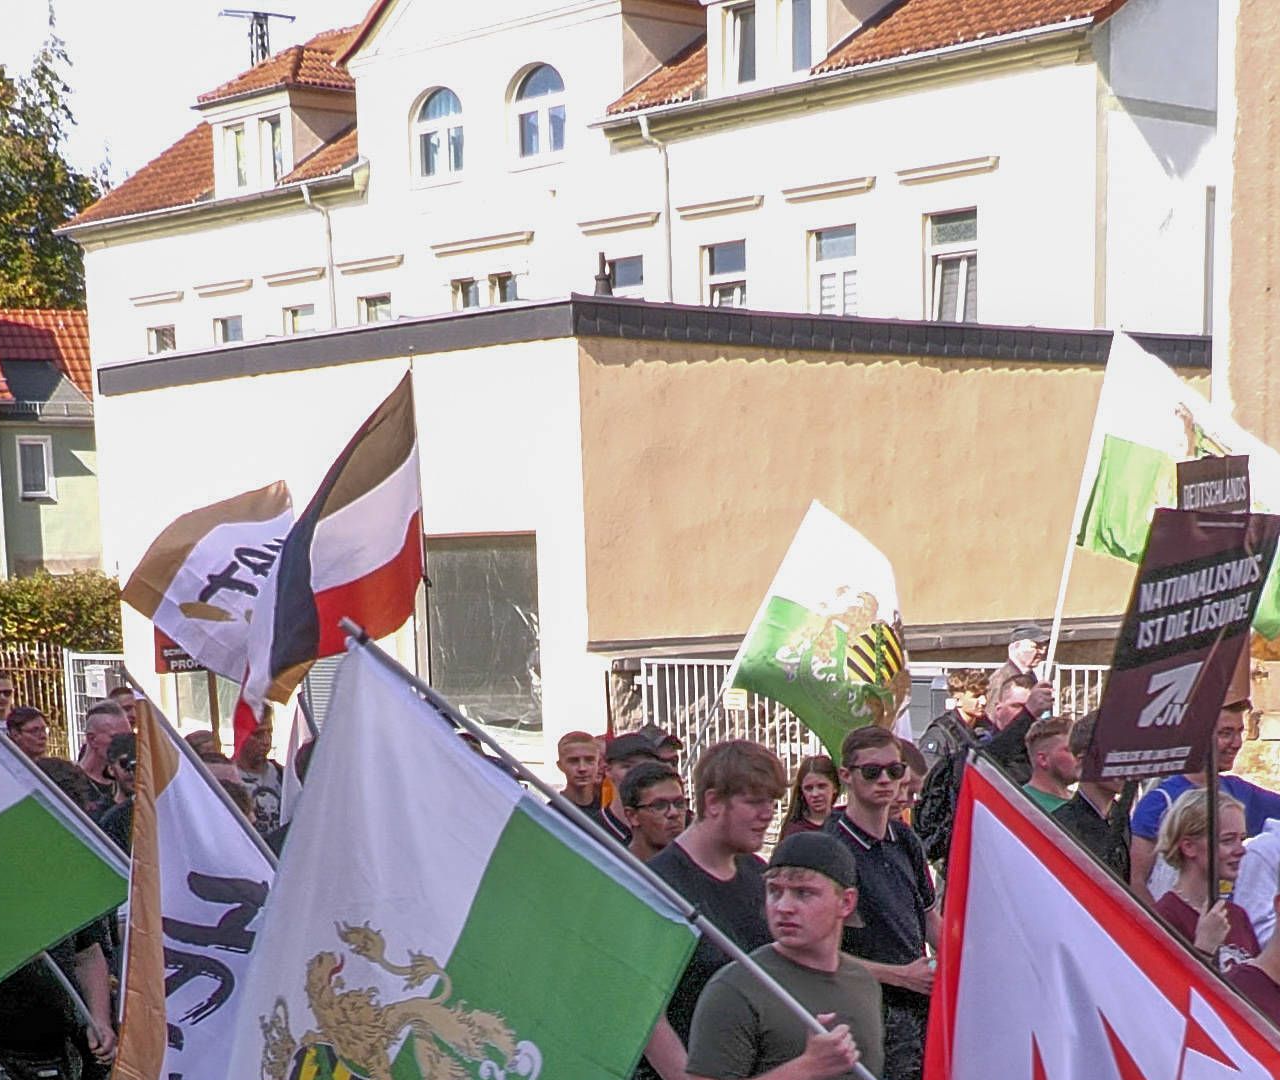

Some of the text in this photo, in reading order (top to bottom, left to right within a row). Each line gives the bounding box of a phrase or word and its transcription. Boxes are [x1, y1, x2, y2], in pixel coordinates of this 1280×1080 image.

[1182, 476, 1248, 510] DEUTSCHLANDS
[1138, 555, 1263, 613] NATIONALISMUS
[1136, 591, 1253, 650] IST DIE LÖSUNG!
[1154, 703, 1189, 726] JN
